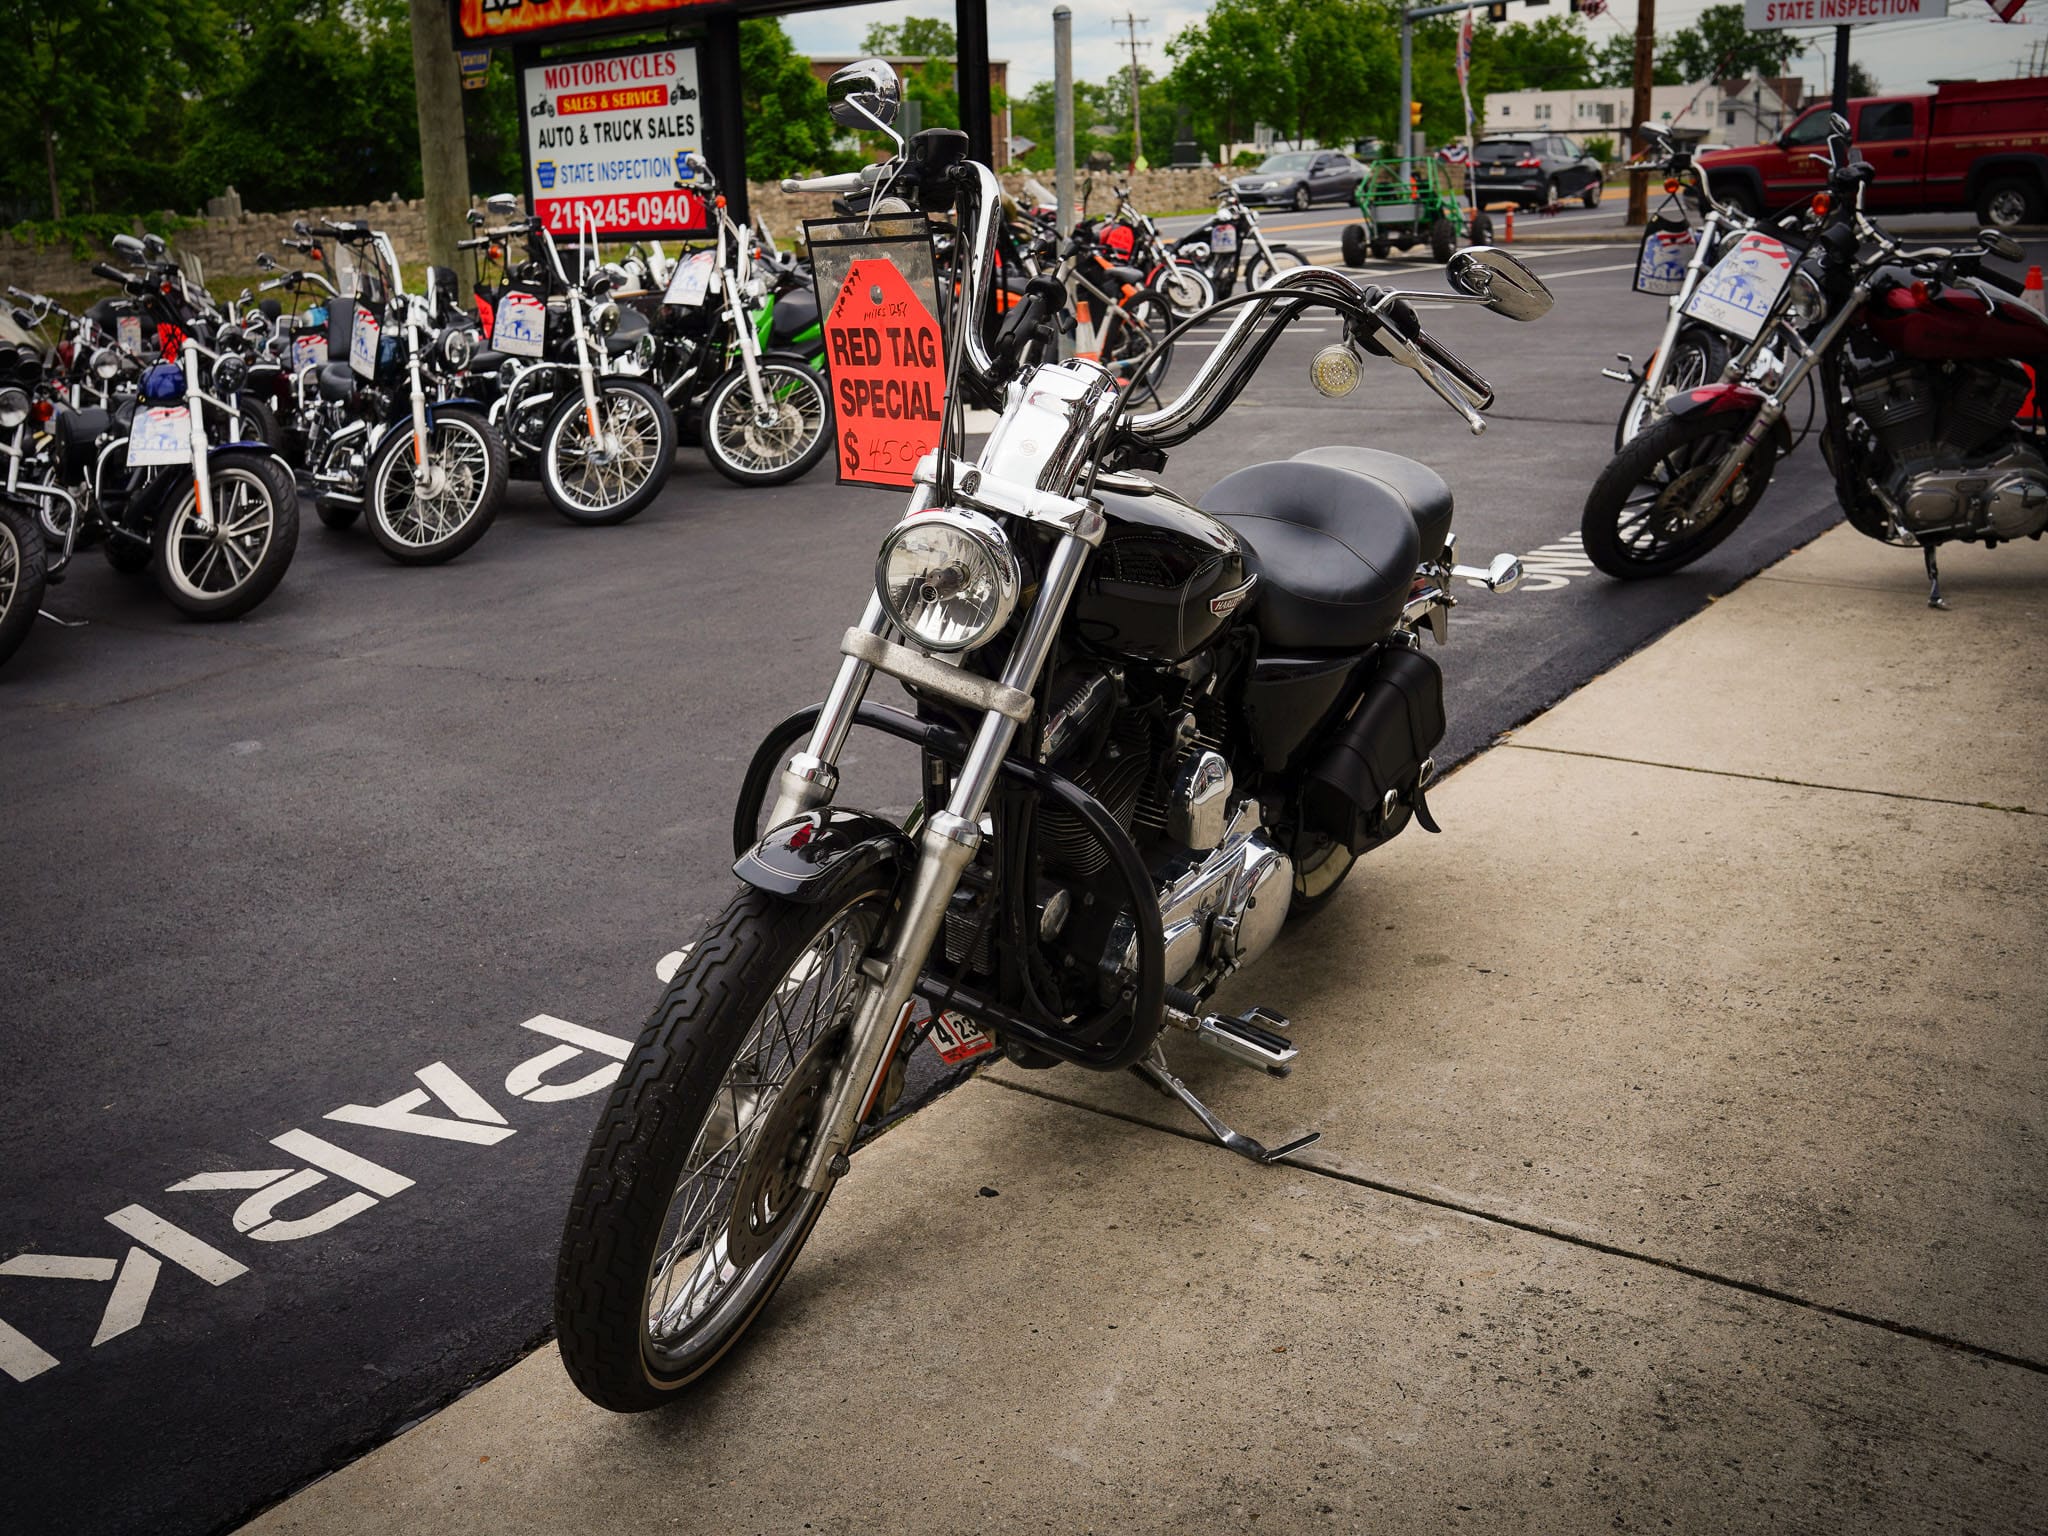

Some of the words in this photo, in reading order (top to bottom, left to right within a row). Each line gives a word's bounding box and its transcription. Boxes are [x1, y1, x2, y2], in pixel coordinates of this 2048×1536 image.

[1766, 2, 1815, 22] STATE
[1819, 0, 1921, 19] INSPECTION
[544, 52, 677, 90] MOTORCYCLES
[562, 95, 597, 113] SALES
[601, 95, 609, 109] &
[611, 88, 662, 107] SERVICE
[538, 125, 574, 149] AUTO
[579, 124, 589, 145] &
[593, 118, 643, 143] TRUCK
[648, 113, 695, 139] SALES
[560, 162, 595, 184] STATE
[597, 156, 672, 182] INSPECTION
[830, 327, 882, 367] RED
[886, 326, 937, 368] TAG
[839, 378, 941, 422] SPECIAL
[953, 1016, 979, 1040] 23
